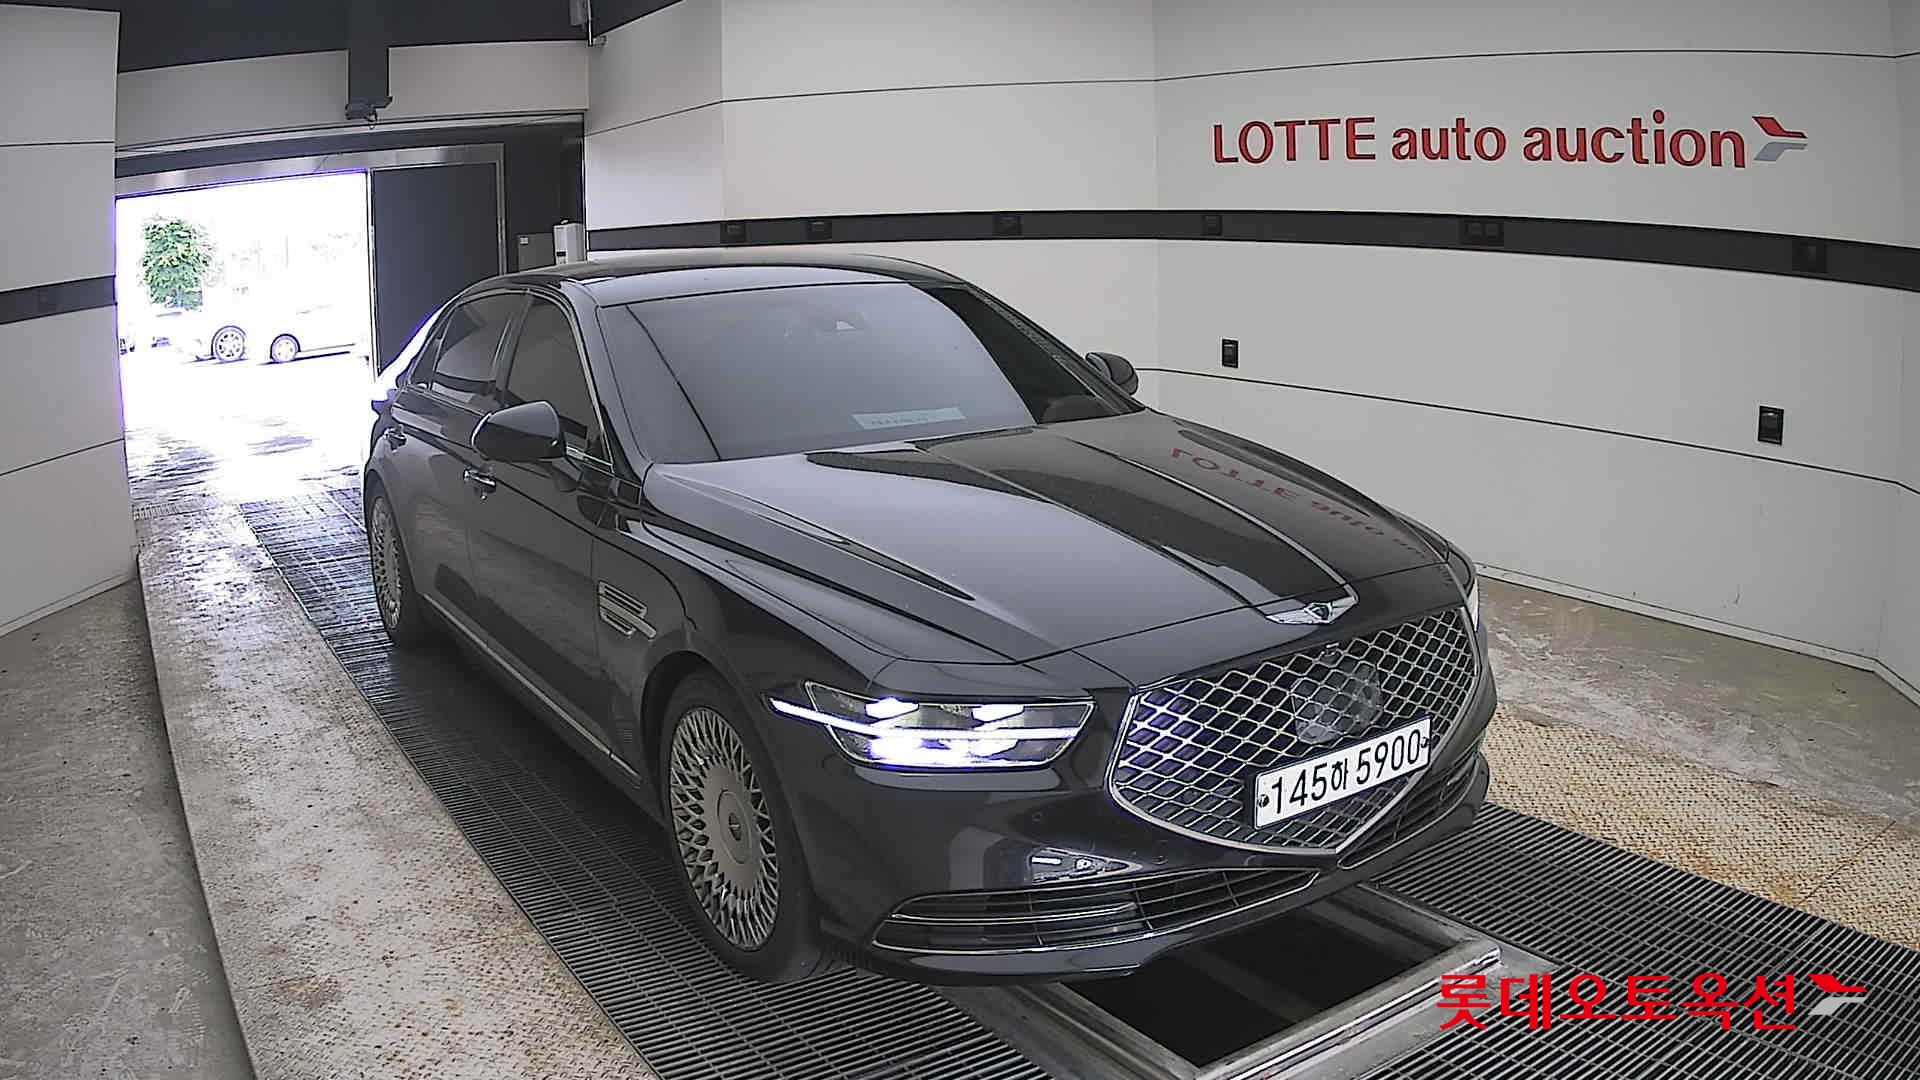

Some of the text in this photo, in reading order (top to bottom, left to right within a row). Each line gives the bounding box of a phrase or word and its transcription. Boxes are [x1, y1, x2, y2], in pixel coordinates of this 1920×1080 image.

[1213, 108, 1746, 168] LOTTE auto auction
[1271, 729, 1421, 814] 145하 5900
